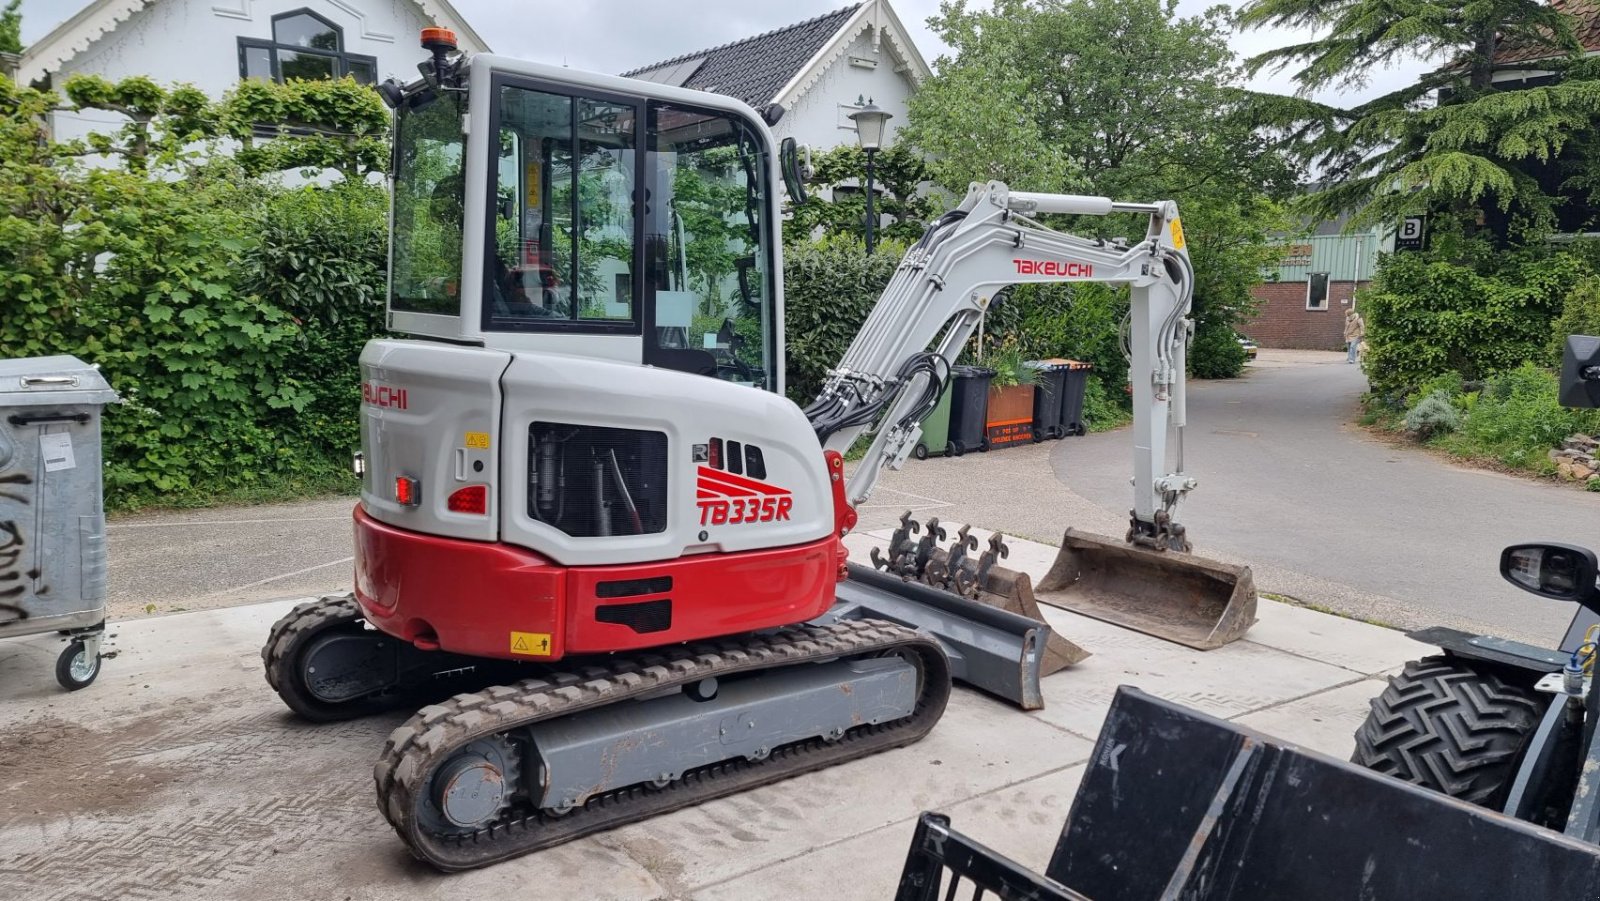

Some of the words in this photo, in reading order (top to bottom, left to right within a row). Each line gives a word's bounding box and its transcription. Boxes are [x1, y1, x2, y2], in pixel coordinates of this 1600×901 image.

[1404, 222, 1417, 236] B
[1012, 259, 1093, 278] TAKEUCHI
[695, 444, 708, 461] R
[696, 496, 793, 527] TB335R
